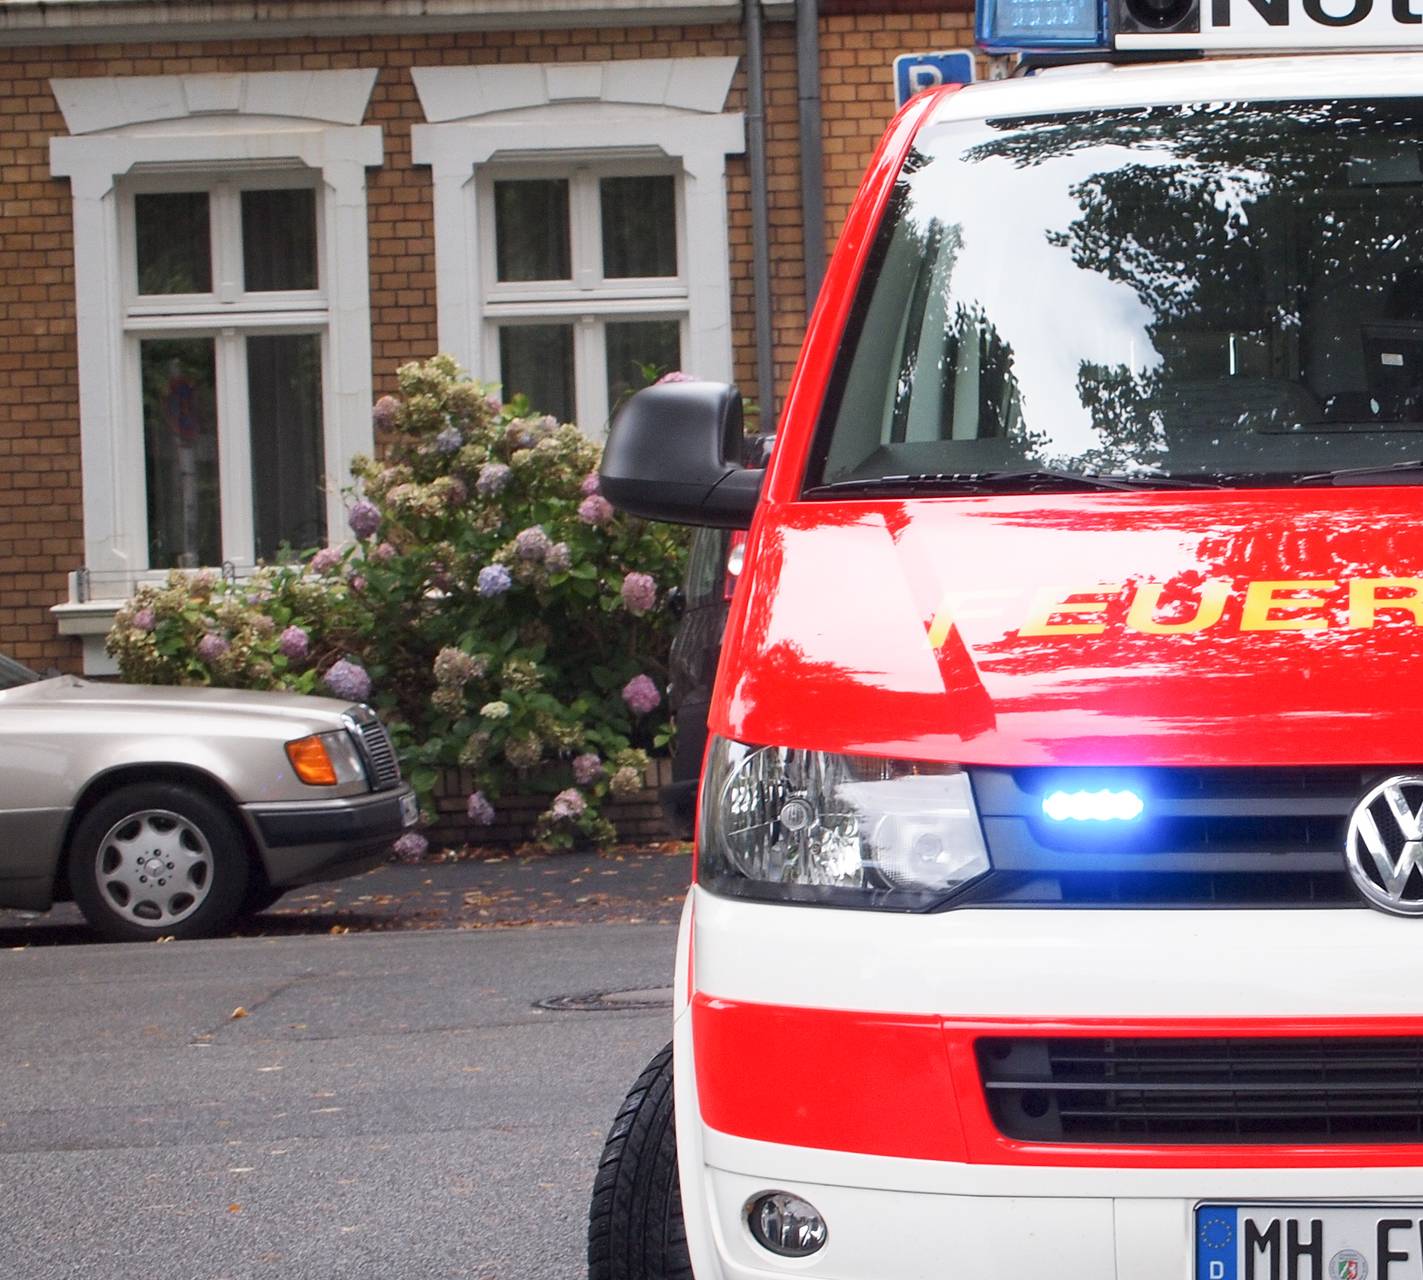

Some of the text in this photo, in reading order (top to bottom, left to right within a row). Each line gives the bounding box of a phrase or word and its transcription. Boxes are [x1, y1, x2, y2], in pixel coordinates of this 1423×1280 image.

[909, 65, 942, 94] P
[1244, 1218, 1323, 1280] MH
[1210, 1260, 1224, 1279] D
